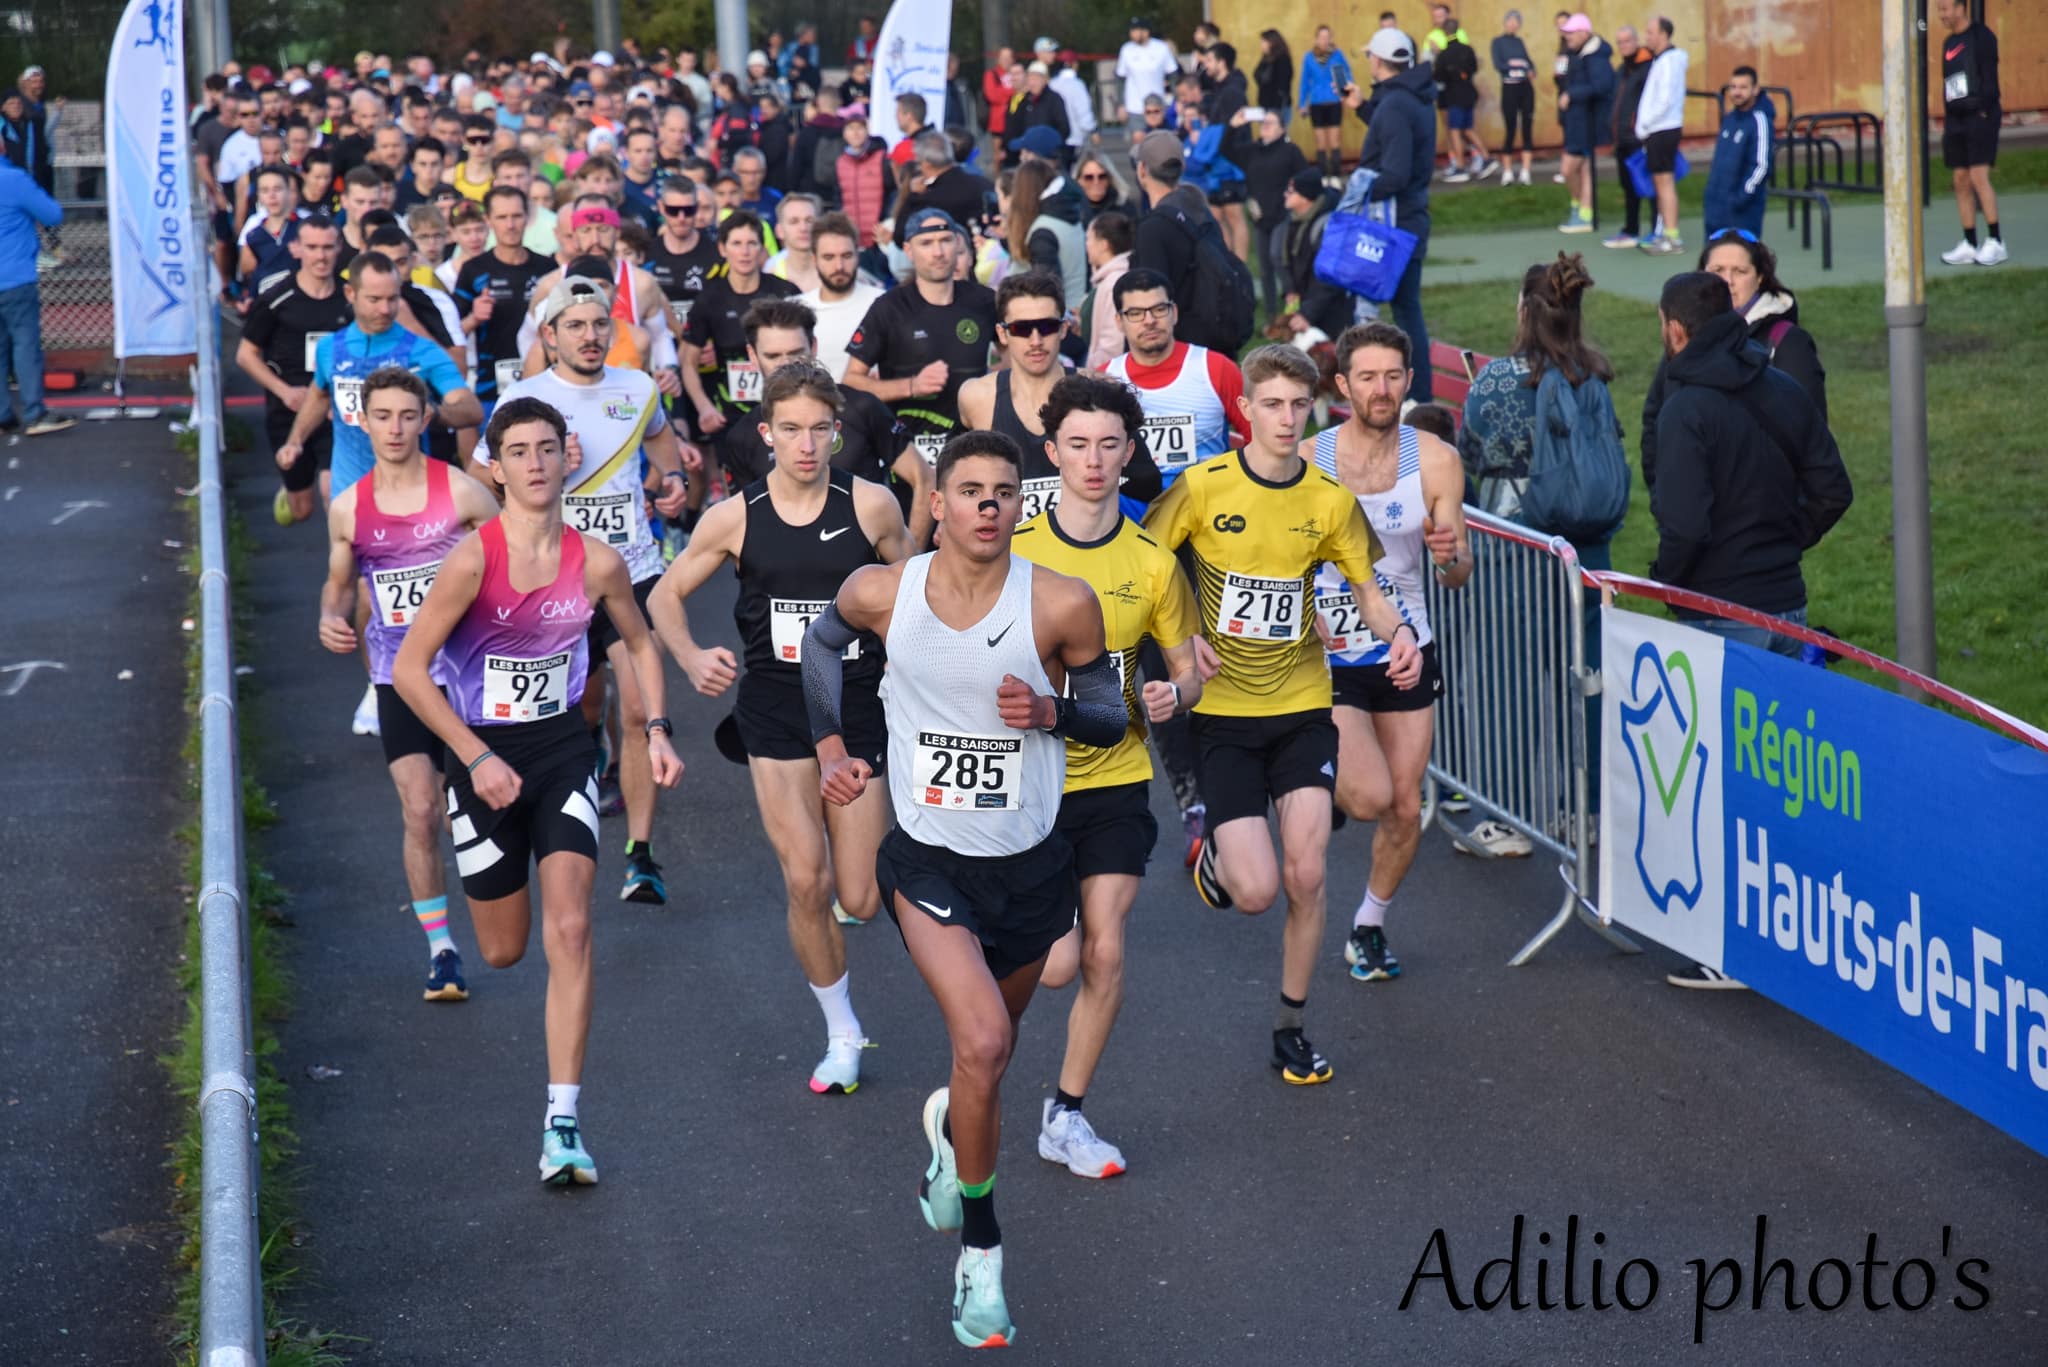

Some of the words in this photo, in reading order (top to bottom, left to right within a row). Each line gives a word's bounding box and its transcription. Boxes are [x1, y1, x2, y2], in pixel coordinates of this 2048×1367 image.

[159, 216, 182, 256] de
[738, 372, 759, 390] 67
[1152, 416, 1188, 426] SAISONS
[575, 505, 625, 532] 345
[379, 574, 395, 583] LES
[1233, 577, 1251, 588] LES
[1254, 579, 1260, 589] 4
[1262, 580, 1300, 591] SAISONS
[778, 603, 797, 613] LES
[799, 604, 806, 612] 4
[1233, 591, 1293, 622] 218
[1322, 597, 1344, 608] LES
[493, 659, 514, 671] LES
[516, 662, 523, 671] 4
[525, 656, 564, 671] SAISONS
[512, 672, 549, 703] 92
[925, 734, 947, 747] LES
[950, 738, 958, 748] 4
[960, 738, 1015, 751] SAISONS
[1734, 687, 1862, 821] Région
[930, 750, 1005, 790] 285
